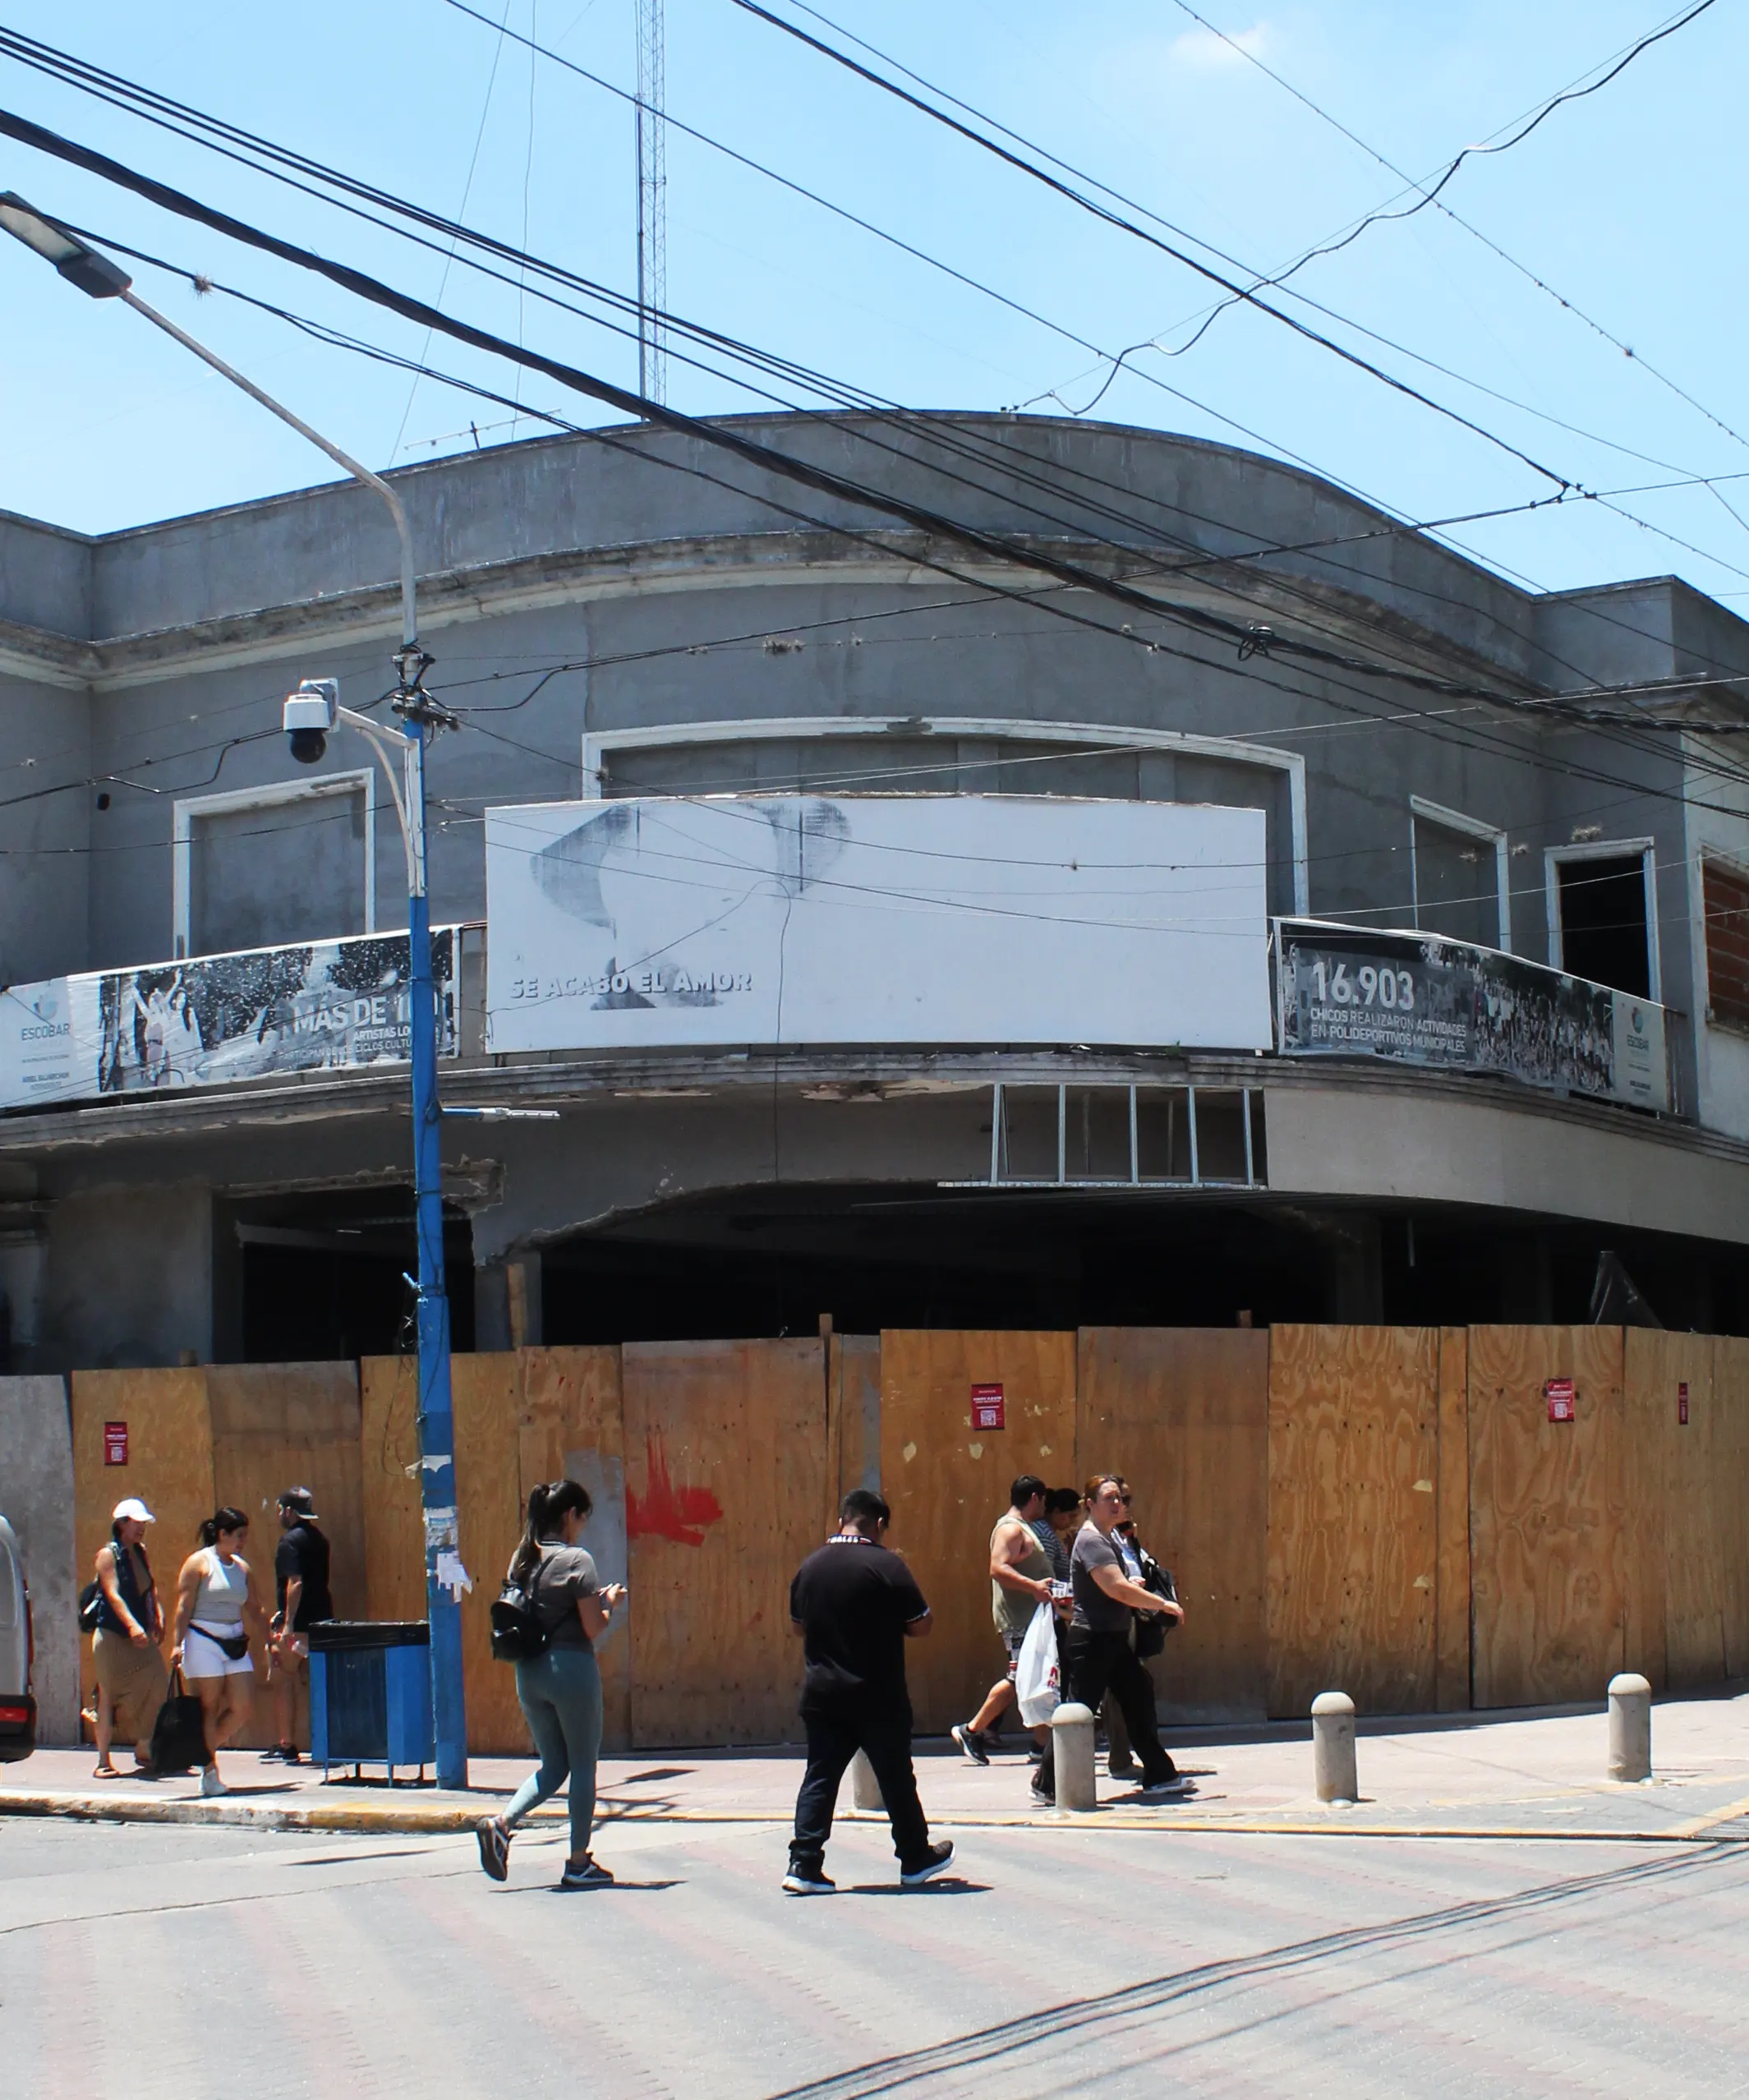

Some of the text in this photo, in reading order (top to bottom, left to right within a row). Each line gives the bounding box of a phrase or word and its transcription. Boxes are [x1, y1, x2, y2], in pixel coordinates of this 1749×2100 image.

[510, 979, 539, 998] SE
[638, 973, 668, 994] EL
[673, 971, 753, 992] AMOR
[1312, 961, 1415, 1011] 16.903
[292, 997, 350, 1034] MÁS
[354, 995, 388, 1027] DE
[1310, 1007, 1467, 1037] CHICOS REALIZARON ACTIVIDADES
[21, 1023, 71, 1041] ESCOBAR
[353, 1027, 397, 1042] ARTISTAS
[1312, 1024, 1327, 1038] EN
[1330, 1026, 1413, 1046] POLIDEPORTIVOS
[355, 1040, 384, 1054] CICLOS
